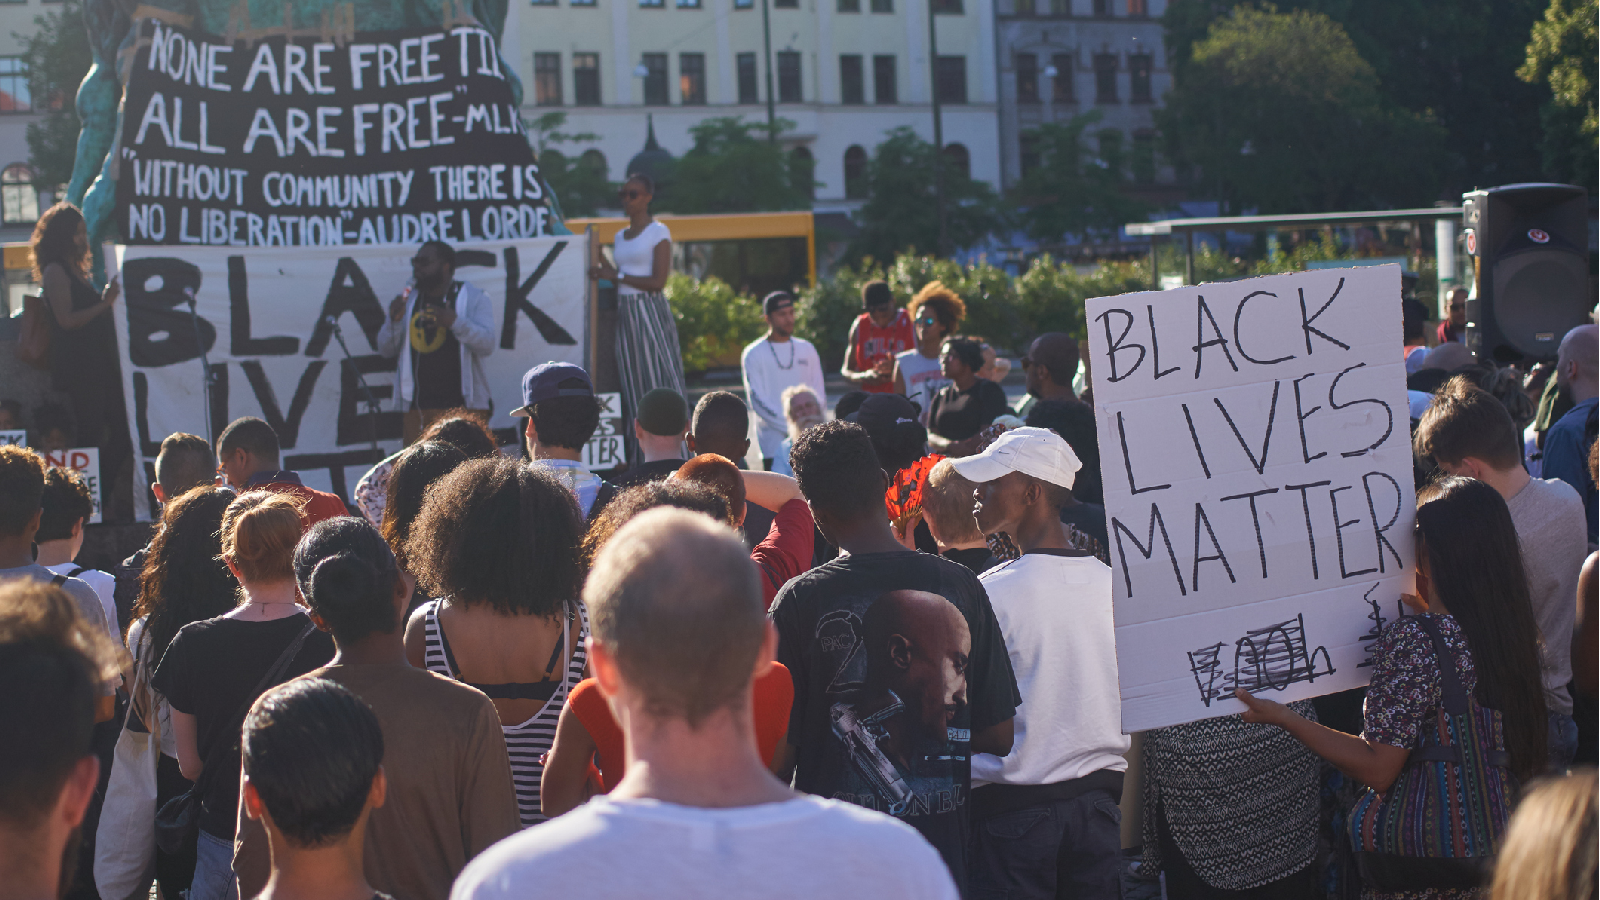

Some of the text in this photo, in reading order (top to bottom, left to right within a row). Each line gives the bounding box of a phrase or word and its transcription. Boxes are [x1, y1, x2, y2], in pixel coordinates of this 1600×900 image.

[243, 43, 335, 94] ARE
[350, 33, 445, 90] FREE
[134, 91, 226, 154] ALL
[243, 107, 345, 157] ARE
[263, 170, 415, 208] COMMUNITY
[429, 164, 508, 201] THERE
[513, 165, 542, 199] IS
[129, 203, 166, 242] NO
[462, 204, 549, 243] LORDE
[1096, 278, 1350, 382] BLACK
[132, 355, 518, 457] LIVE
[1117, 363, 1393, 495] LIVES
[1111, 472, 1402, 598] MATTER
[820, 633, 851, 652] PAC
